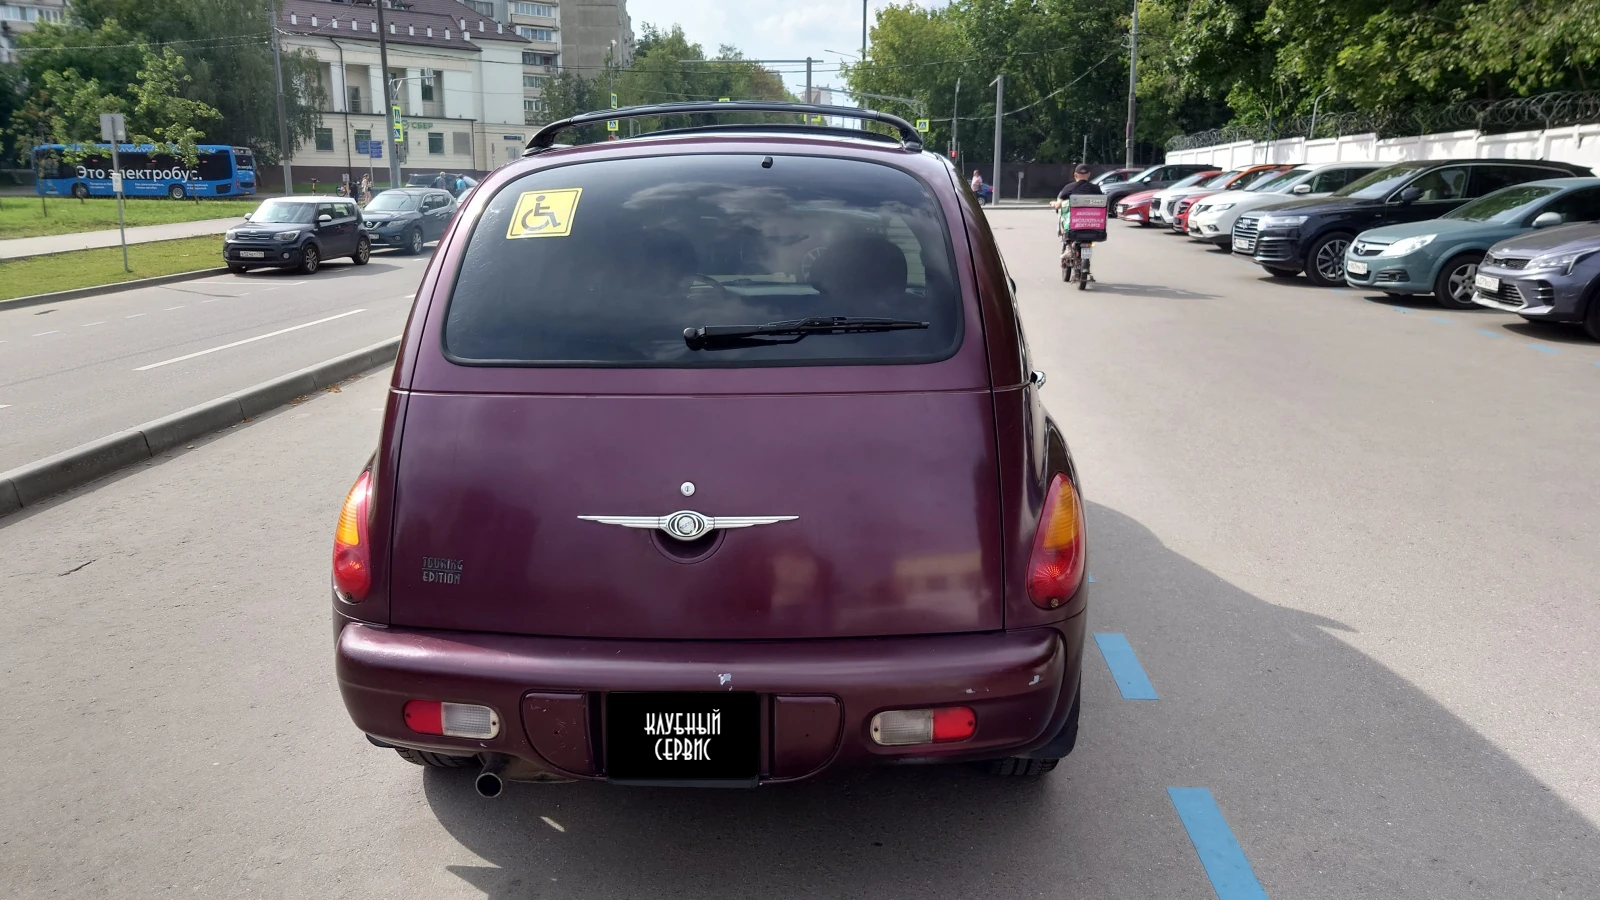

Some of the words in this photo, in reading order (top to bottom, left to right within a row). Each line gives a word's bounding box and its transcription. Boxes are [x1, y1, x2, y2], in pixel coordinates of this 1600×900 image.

[411, 121, 433, 129] СБЕР
[76, 165, 105, 179] Это
[422, 556, 463, 570] TOURING
[422, 571, 460, 584] EDITION
